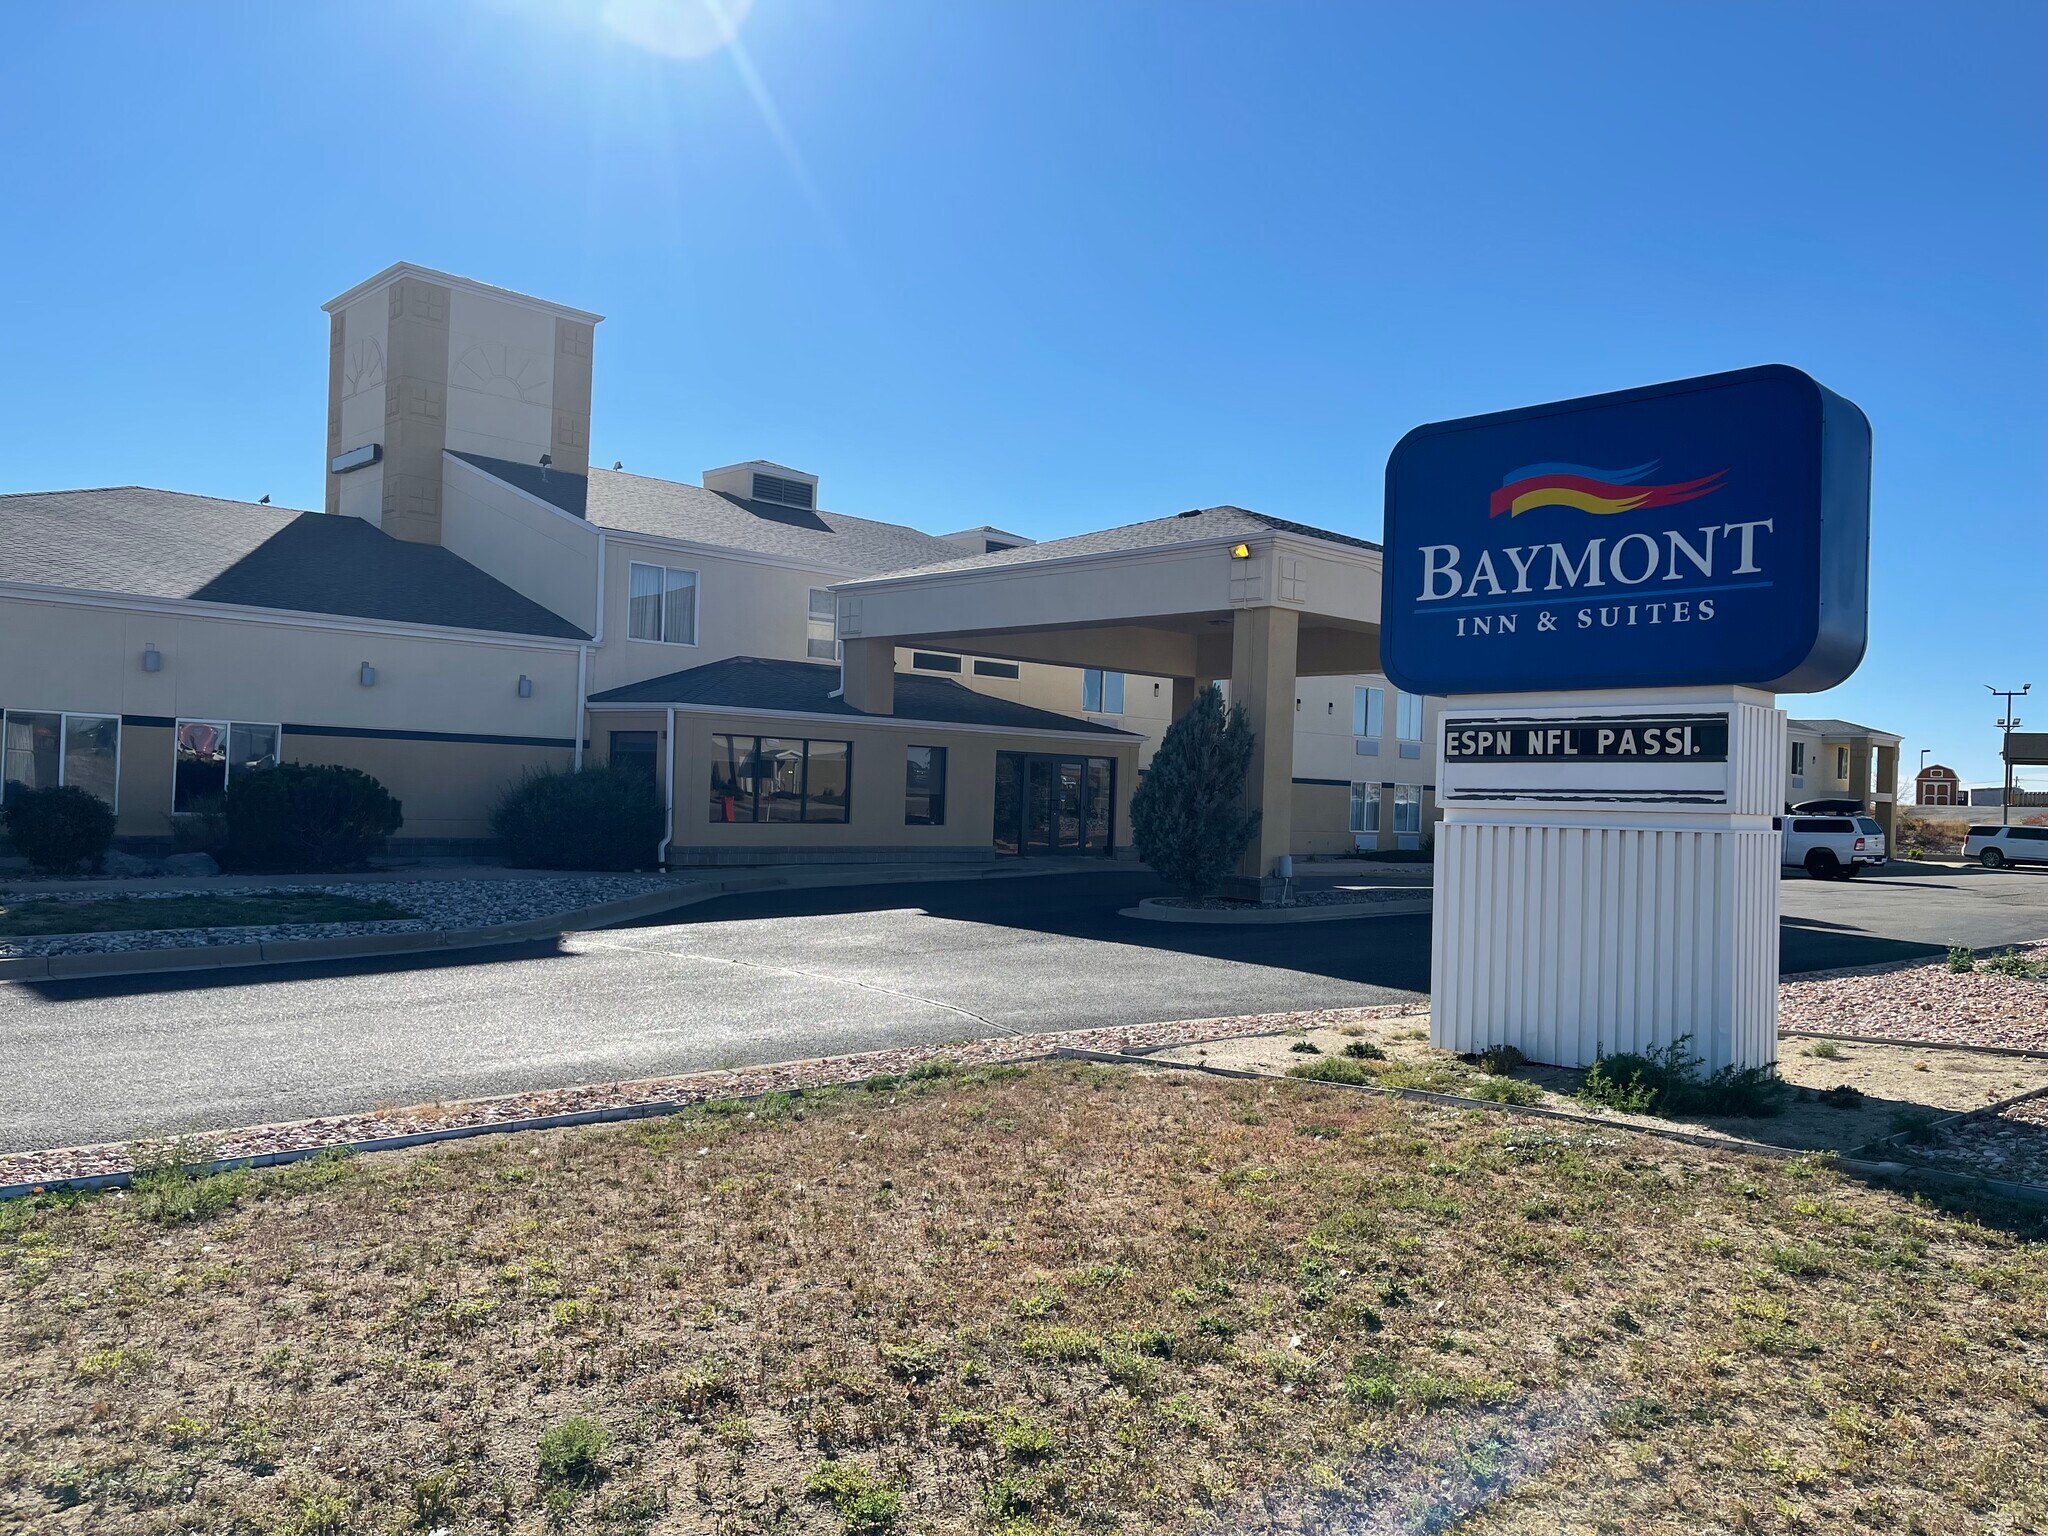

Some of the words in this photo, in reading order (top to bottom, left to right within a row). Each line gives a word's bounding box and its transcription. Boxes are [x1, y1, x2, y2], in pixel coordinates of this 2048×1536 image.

[1416, 518, 1773, 602] BAYMONT
[1456, 613, 1518, 637] INN
[1537, 611, 1558, 632] &
[1577, 599, 1716, 629] SUITES
[1445, 730, 1511, 756] ESPN
[1528, 729, 1578, 755] NFL
